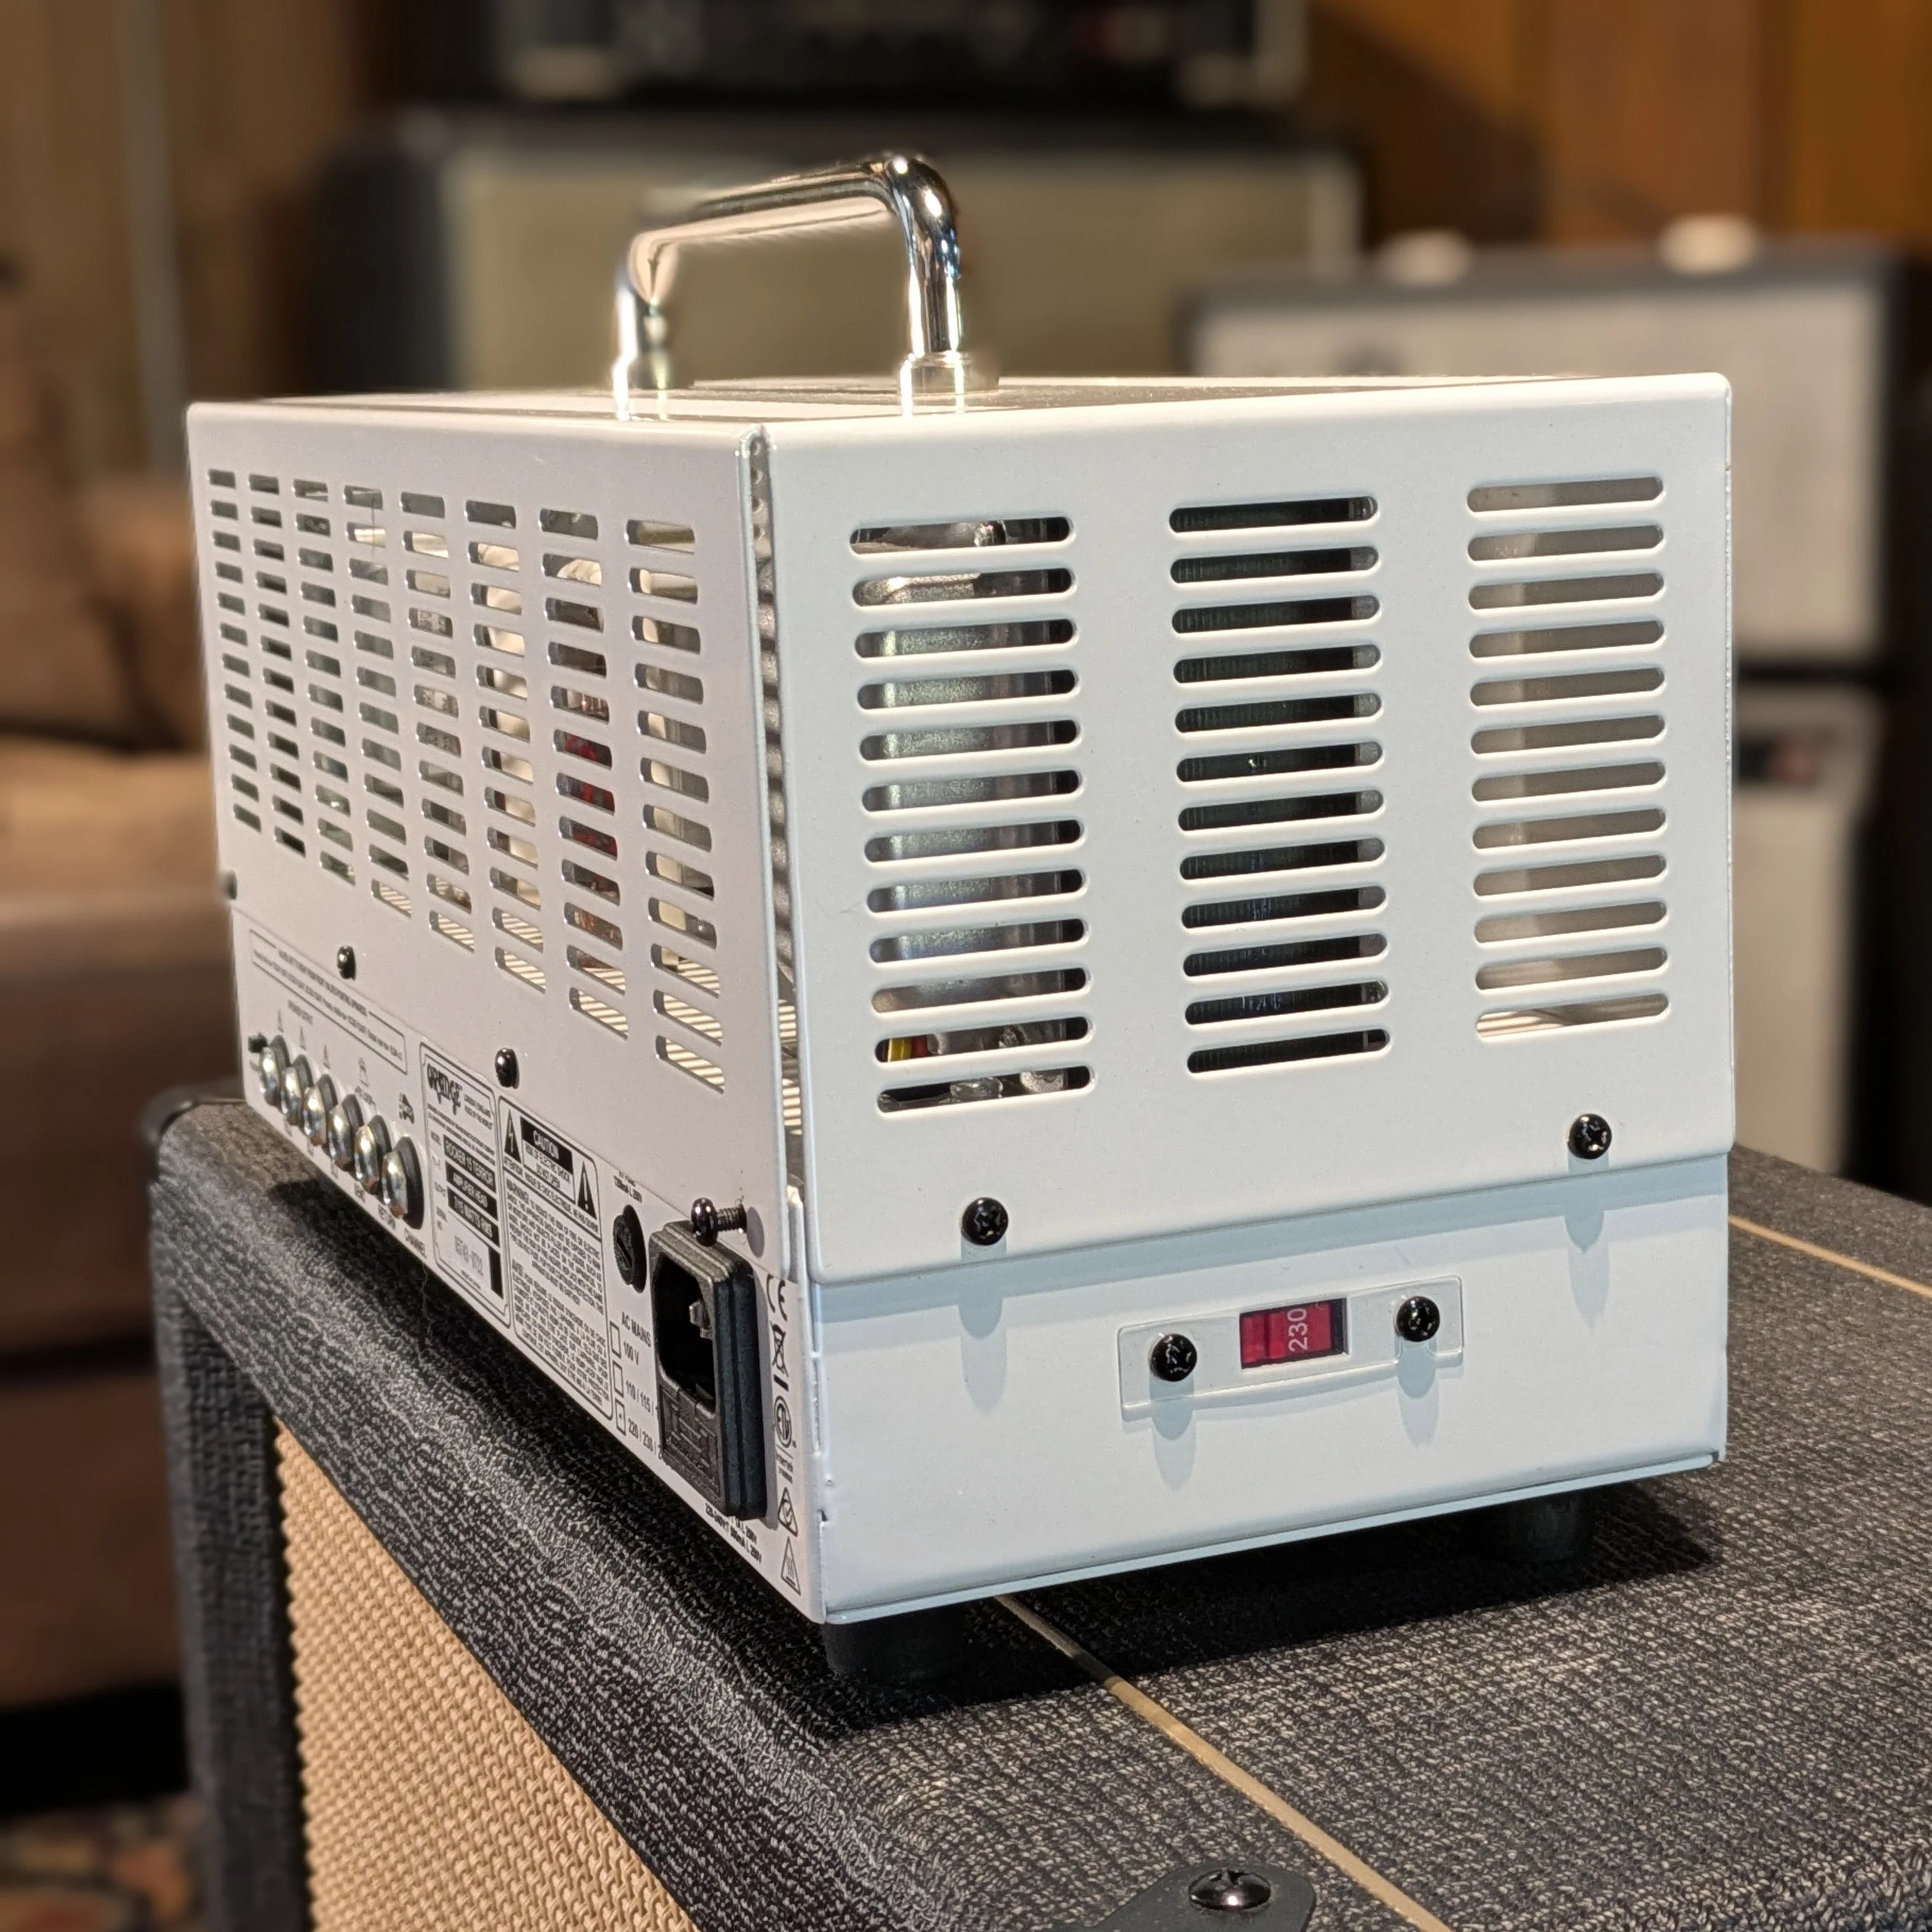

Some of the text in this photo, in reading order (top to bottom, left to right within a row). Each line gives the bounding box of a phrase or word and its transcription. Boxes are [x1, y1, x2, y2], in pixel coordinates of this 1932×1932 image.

[533, 1129, 559, 1160] CAUTION
[622, 1312, 651, 1347] AC MAINS
[1287, 1307, 1309, 1352] 230
